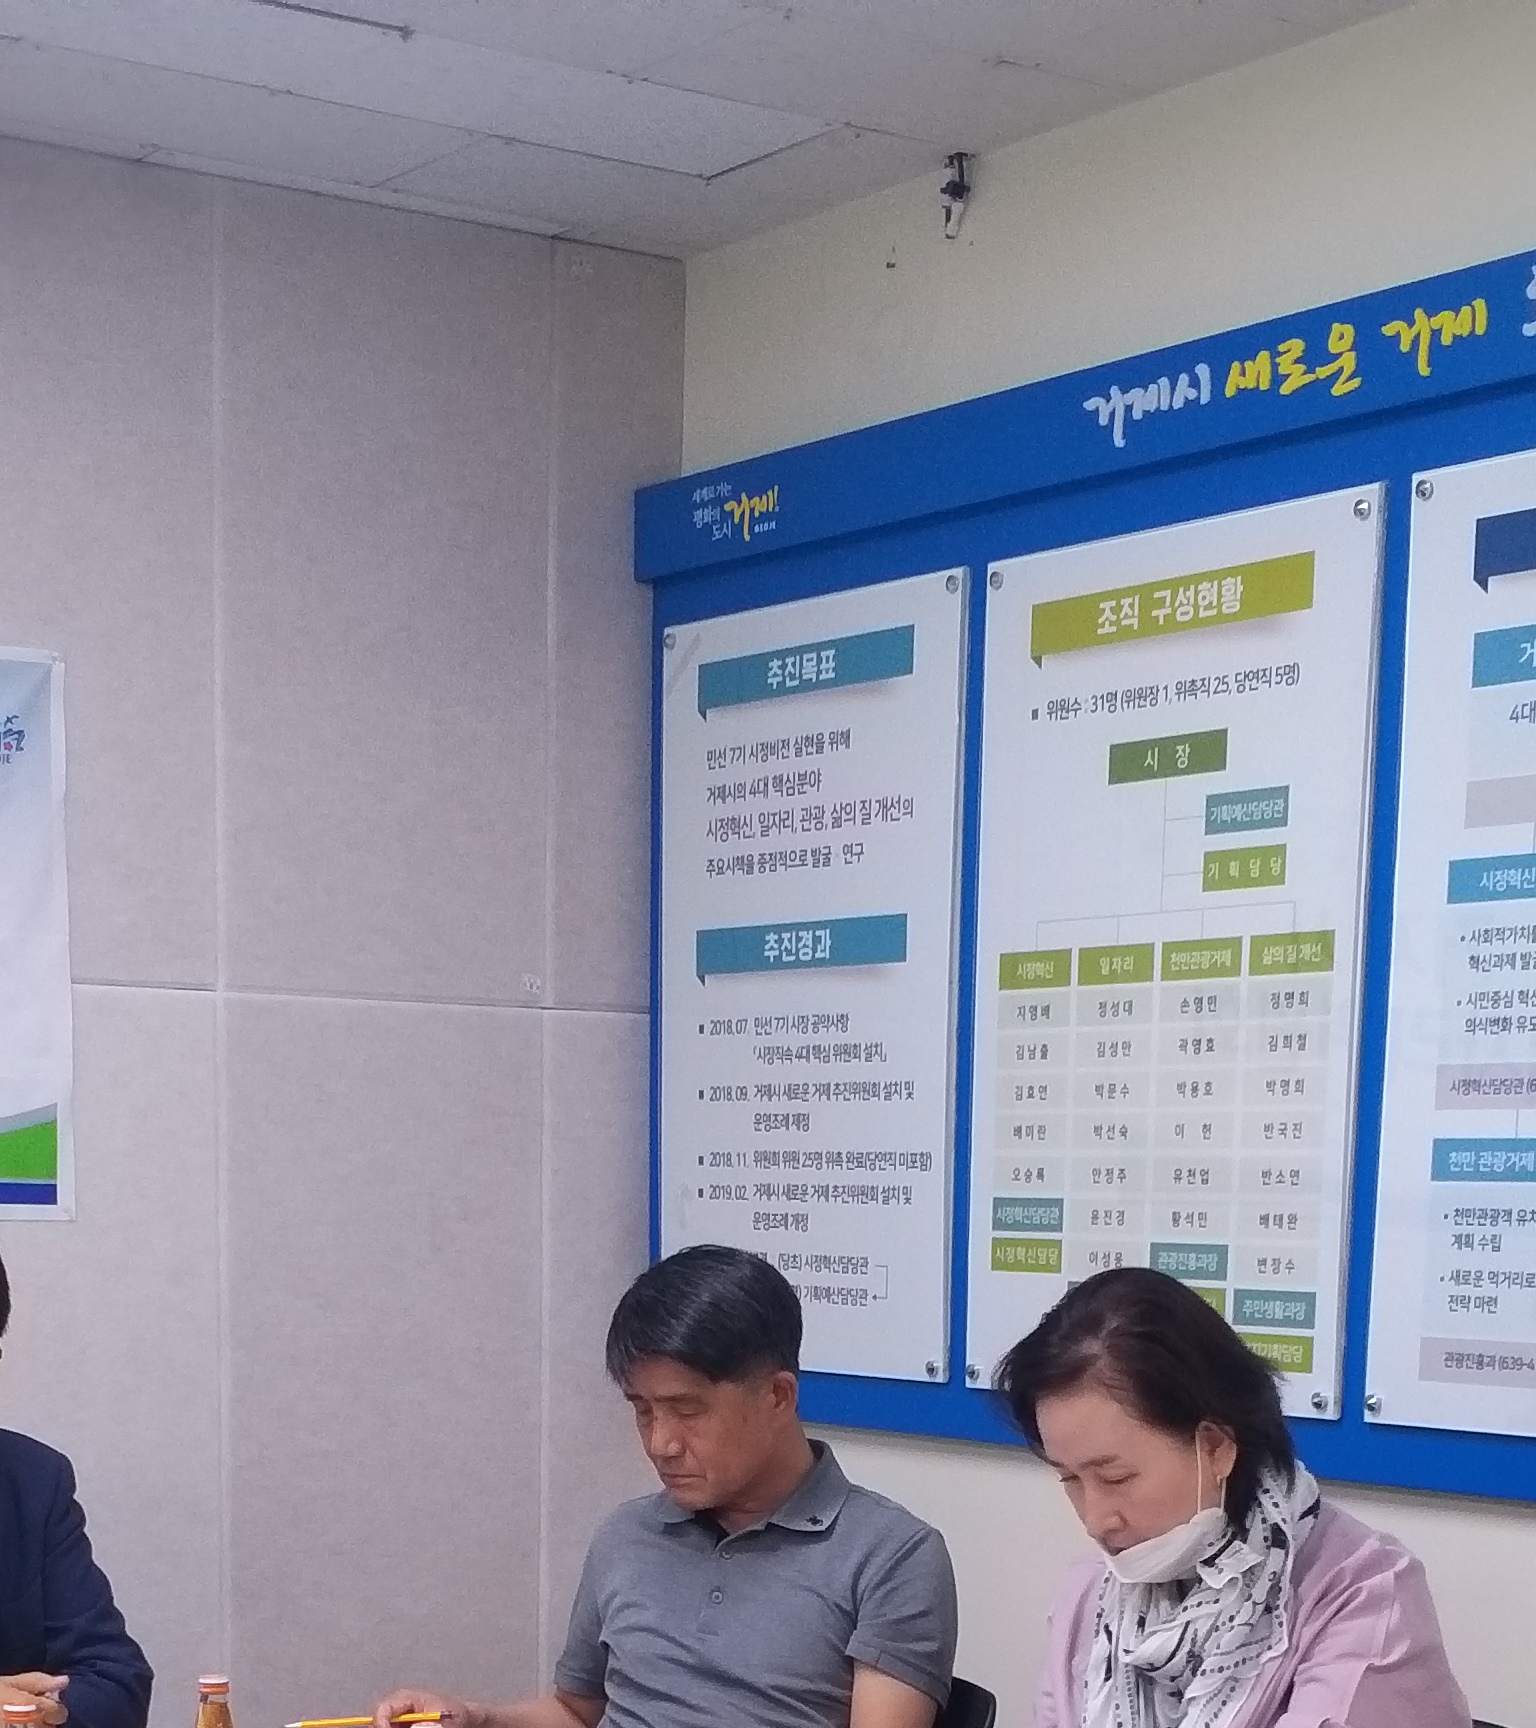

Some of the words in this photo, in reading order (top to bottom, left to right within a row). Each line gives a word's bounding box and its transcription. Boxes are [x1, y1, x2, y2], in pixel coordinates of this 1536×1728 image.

[1083, 362, 1212, 449] 거제시
[1225, 324, 1361, 399] 새로운
[1382, 299, 1488, 377] 거제
[712, 520, 731, 541] 도시
[1097, 595, 1139, 635] 조직
[1151, 575, 1244, 626] 구성현황
[768, 650, 835, 689] 추진목표
[1047, 698, 1082, 720] 위원수
[1090, 690, 1118, 713] 31명
[1121, 685, 1160, 712] (위원장
[1175, 677, 1210, 701] 위촉직
[1213, 675, 1231, 694] 25,
[1235, 666, 1272, 694] 당연직
[1275, 662, 1300, 686] 5명)
[1510, 700, 1536, 724] 4대
[730, 744, 746, 764] 7기
[749, 738, 790, 763] 시정비전
[793, 732, 825, 757] 실현을
[828, 728, 850, 751] 위해
[707, 782, 746, 805] 거제시의
[749, 776, 768, 798] 4대
[772, 768, 821, 797] 핵심분야
[758, 808, 797, 837] 일자리,
[800, 805, 828, 832] 관광,
[831, 801, 856, 829] 삶의
[860, 799, 871, 825] 질
[875, 794, 913, 822] 개선의
[706, 854, 754, 878] 주요시책을
[811, 846, 832, 868] 발굴
[843, 843, 864, 864] 연구
[1480, 868, 1535, 891] 시정혁신
[764, 929, 831, 962] 추진경과
[1468, 952, 1516, 972] 혁신과제
[1466, 990, 1514, 1009] 시민중심
[1465, 1016, 1513, 1035] 의식변화
[1450, 1078, 1524, 1096] 시정혁신담당관
[1449, 1152, 1476, 1171] 천만
[1478, 1151, 1534, 1172] 관광거제
[1454, 1208, 1512, 1227] 천만관광객
[1451, 1233, 1474, 1251] 계획
[1478, 1234, 1502, 1252] 수립
[1448, 1270, 1484, 1288] 새로운
[1488, 1271, 1536, 1289] 먹거리로
[1448, 1295, 1471, 1312] 전략
[1474, 1296, 1498, 1314] 마련
